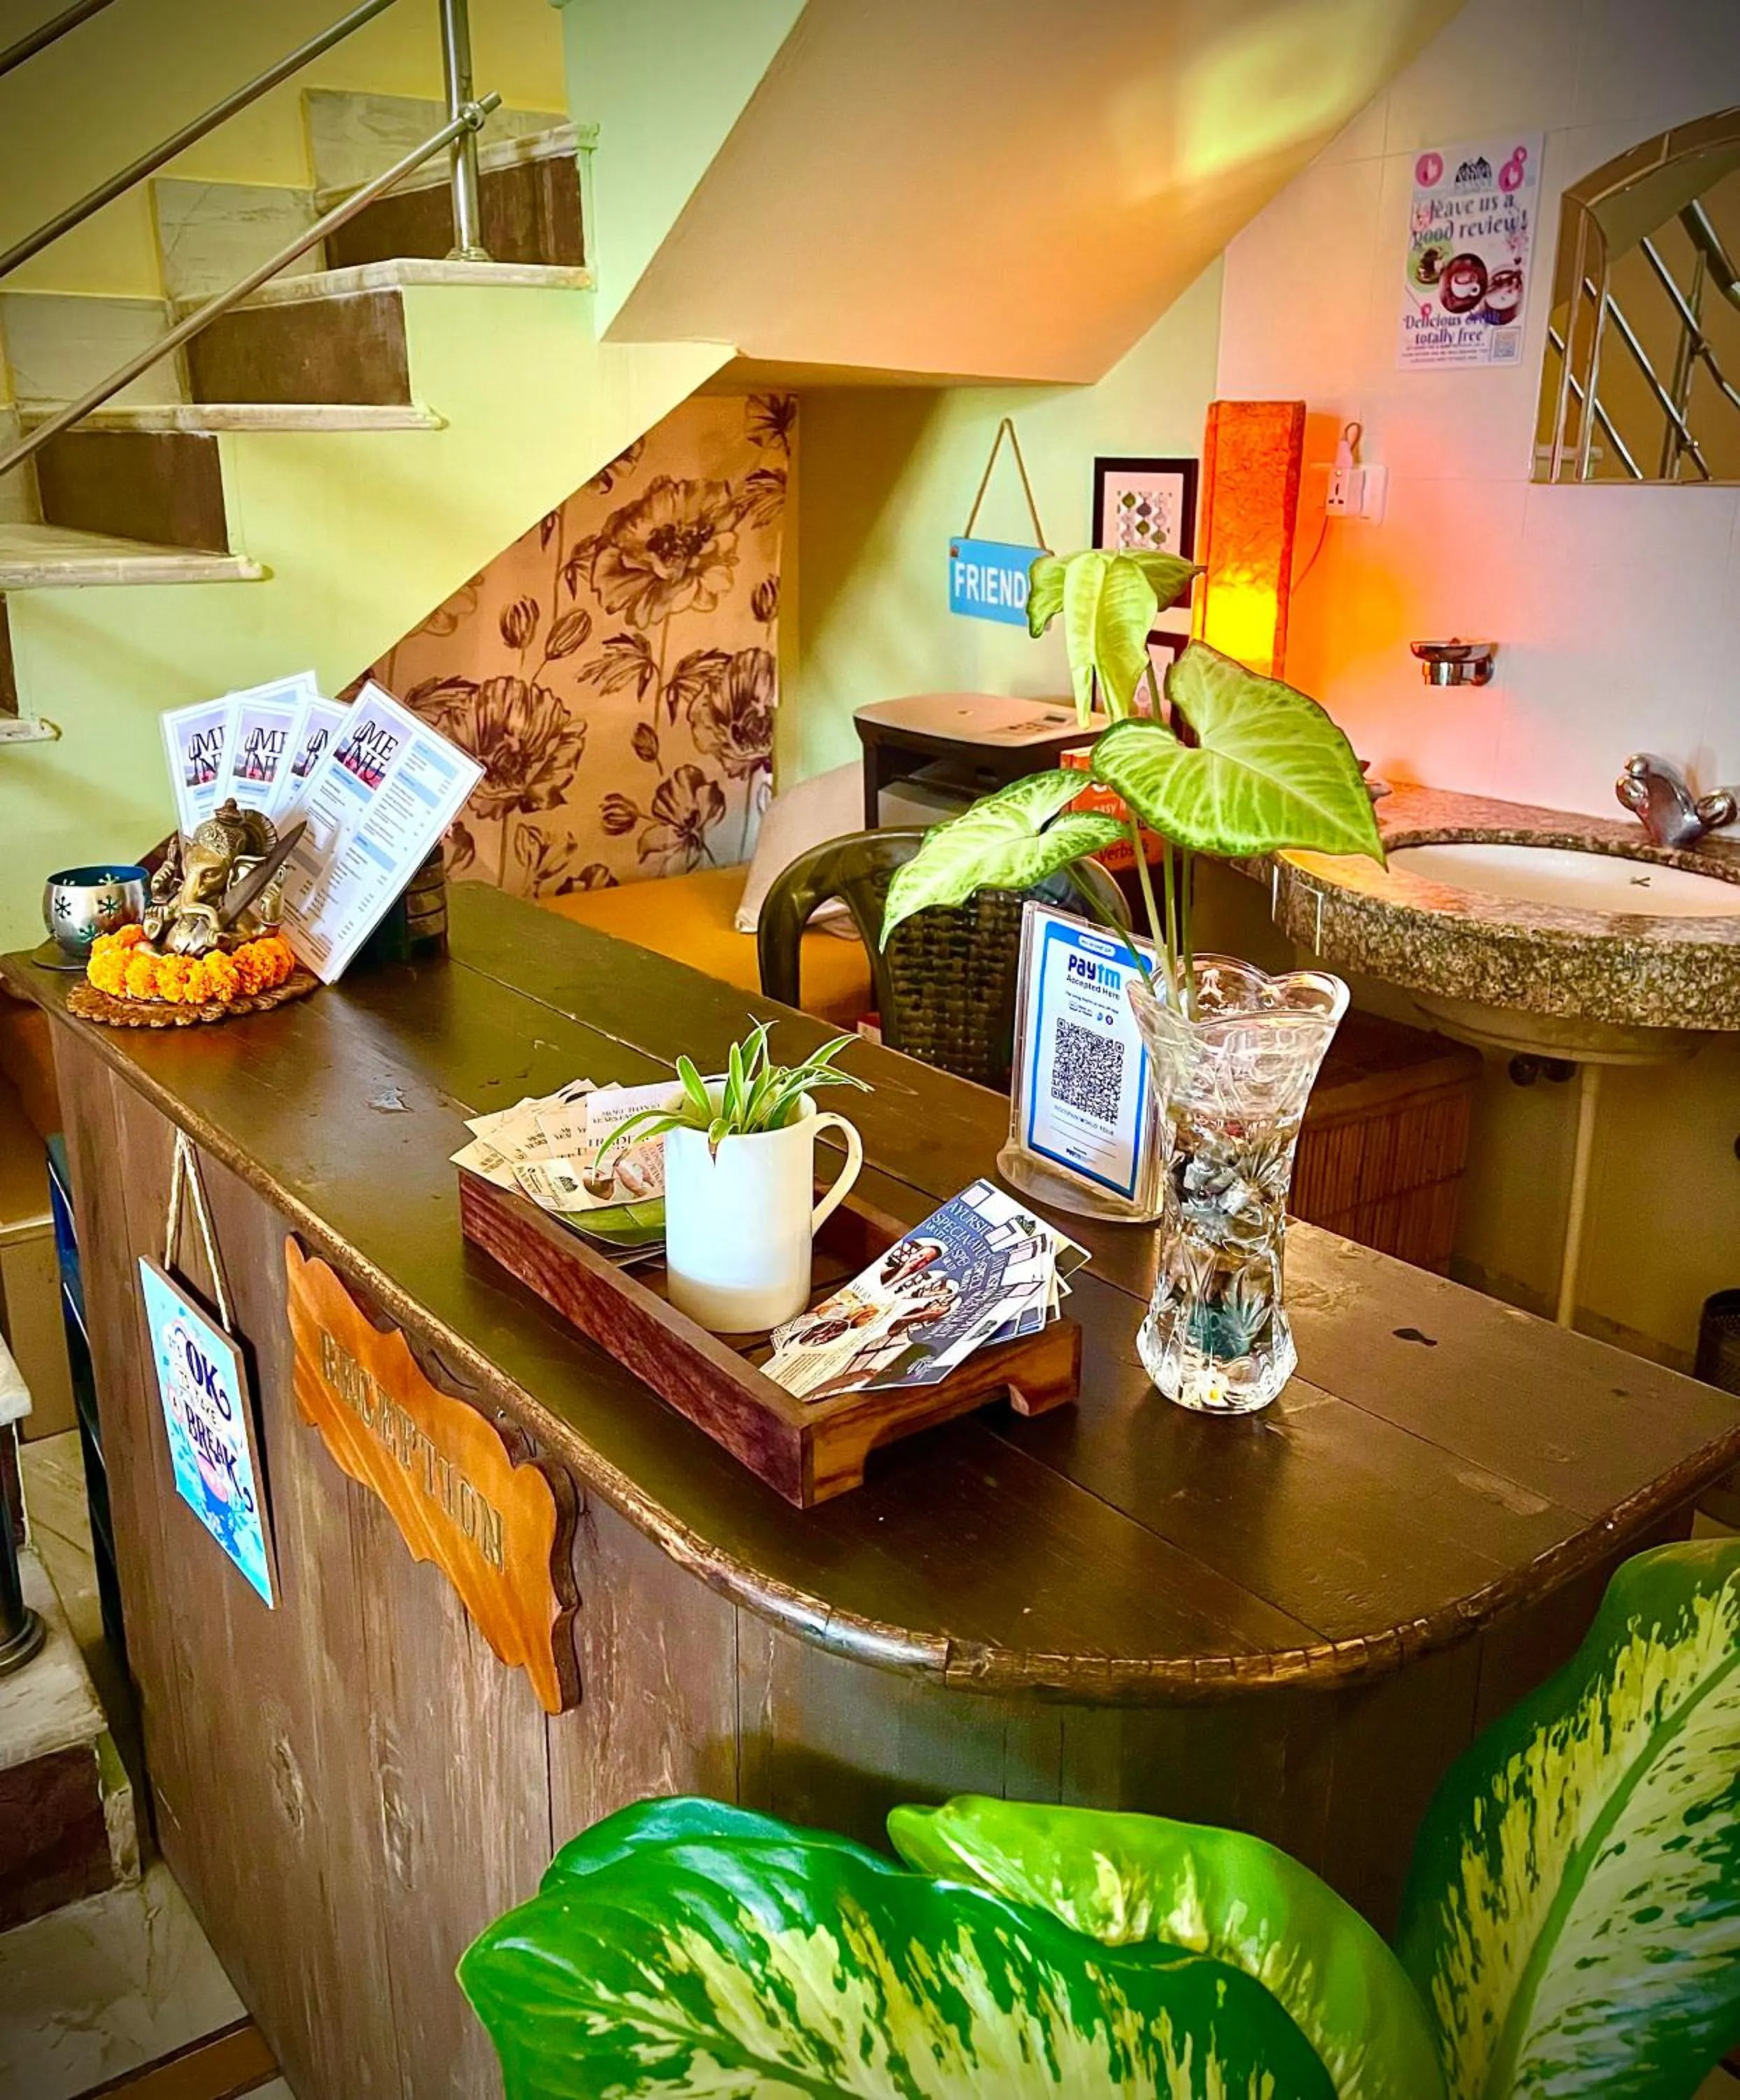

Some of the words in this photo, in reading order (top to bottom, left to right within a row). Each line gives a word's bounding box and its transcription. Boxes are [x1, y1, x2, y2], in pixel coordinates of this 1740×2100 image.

[1479, 197, 1498, 212] us
[1415, 328, 1452, 344] totally
[1458, 328, 1485, 344] free
[954, 561, 1027, 609] FRIEND
[1067, 974, 1101, 993] Accepted
[1102, 988, 1121, 1000] Here
[179, 1332, 232, 1422] OK
[183, 1399, 254, 1513] BREAK
